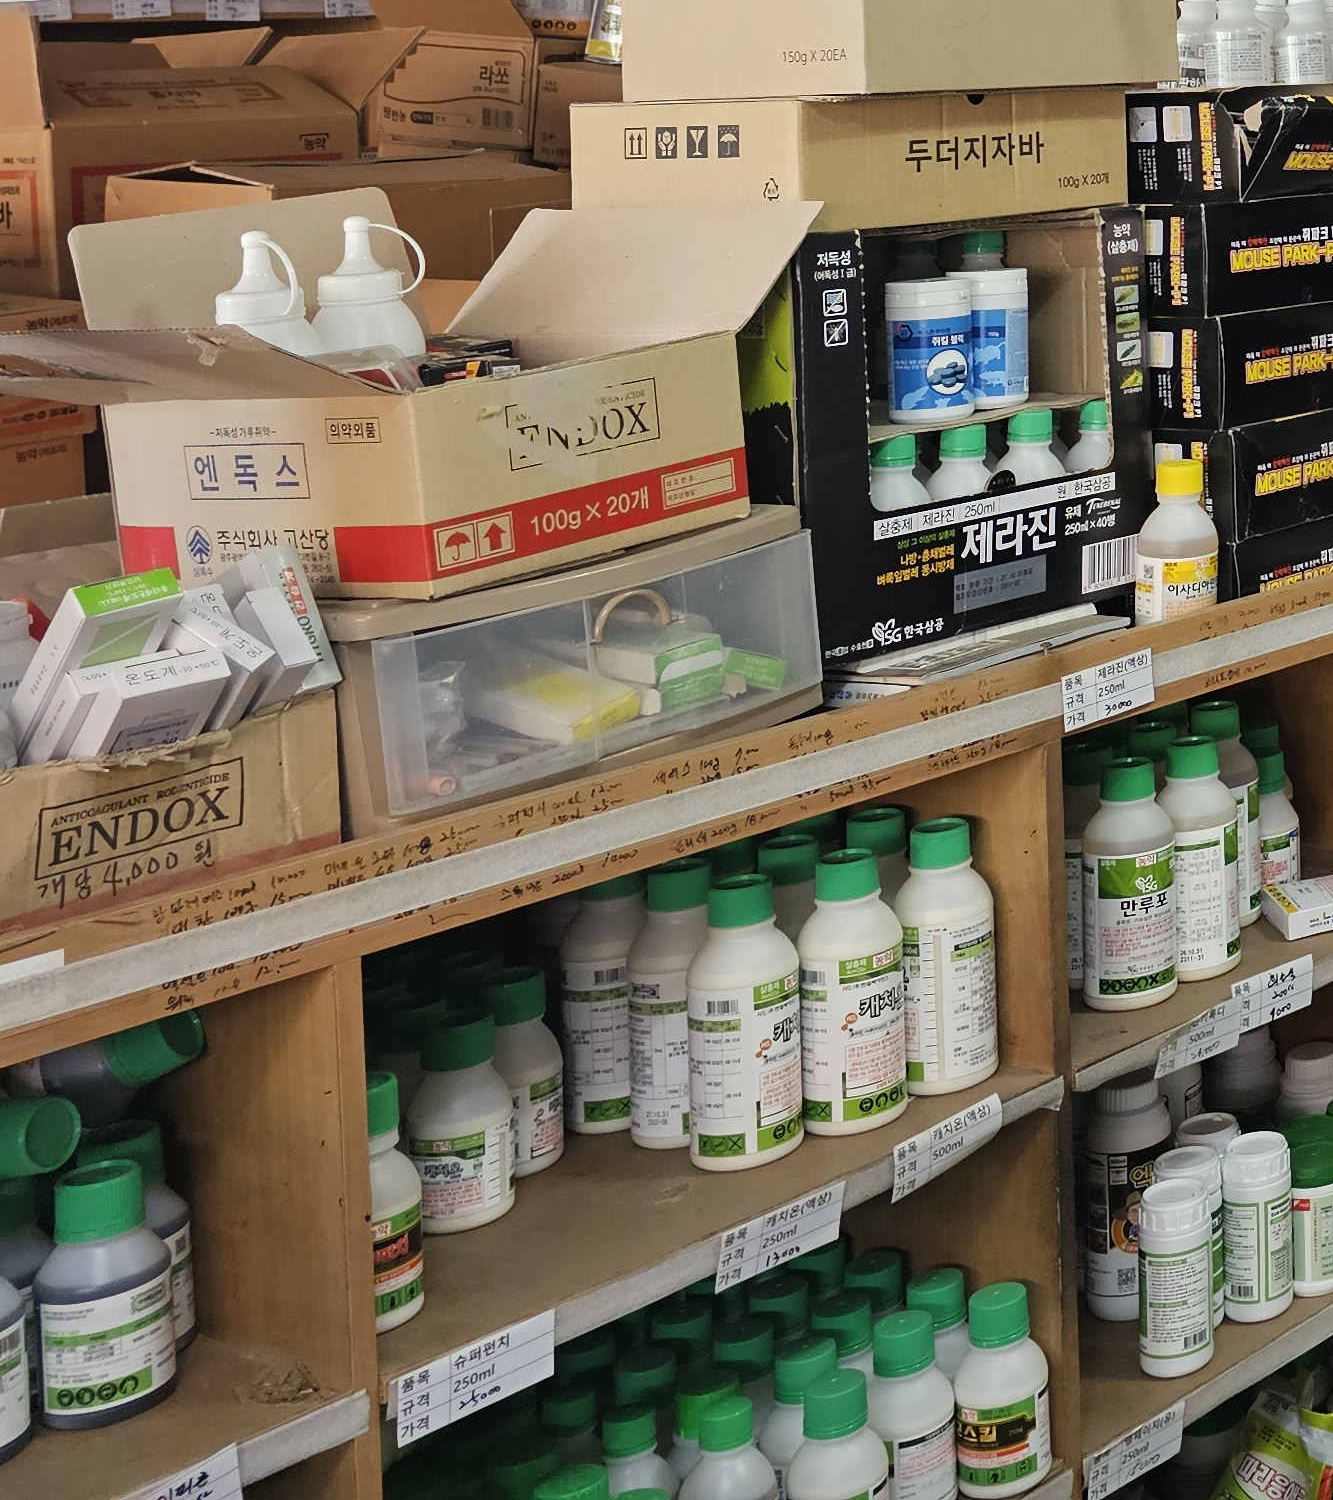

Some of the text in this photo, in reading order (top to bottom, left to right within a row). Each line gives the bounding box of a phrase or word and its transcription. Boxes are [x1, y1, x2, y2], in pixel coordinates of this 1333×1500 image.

[782, 48, 847, 66] 150g 20EA
[302, 136, 326, 151] 농약
[905, 131, 1044, 173] 두더지자바
[1058, 172, 1110, 190] 100g 20개
[1113, 224, 1131, 237] 농약
[816, 249, 851, 268] 저독성
[1107, 238, 1138, 254] (살충제)
[1230, 245, 1281, 273] MOUSE
[1246, 355, 1291, 384] MOUSE
[330, 423, 376, 439] 의약외품
[194, 454, 300, 492] 엔독스
[1255, 466, 1301, 496] MOUSE
[531, 486, 649, 536] 100g 20개
[878, 475, 1111, 537] 살충제 제라진 250ml 원 한국삼공
[217, 530, 278, 550] 주식회사
[961, 506, 1056, 564] 제라진
[904, 618, 944, 639] 한국삼공
[125, 665, 178, 685] 온도계
[1064, 653, 1149, 691] 품목 제라진(액상)
[1065, 680, 1126, 709] 규격 250ml
[1065, 710, 1086, 727] 가격
[50, 773, 230, 827] ANTICOAGULANT RODENTICIDE
[48, 786, 230, 867] ENDOX
[37, 868, 92, 909] 개당
[102, 852, 178, 896] 4,000
[1120, 893, 1169, 918] 만루포
[896, 1102, 991, 1164] 품목 캐치온(액상)
[897, 1137, 965, 1179] 규격 500ml
[724, 1188, 833, 1247] 품목 캐치온(액상)
[720, 1223, 798, 1268] 규격 250ml
[718, 1267, 743, 1287] 가격
[401, 1332, 510, 1393] 품목 슈퍼펀치
[401, 1363, 495, 1417] 규격 250ml
[401, 1416, 430, 1439] 가격
[1122, 1443, 1150, 1465] 250ml
